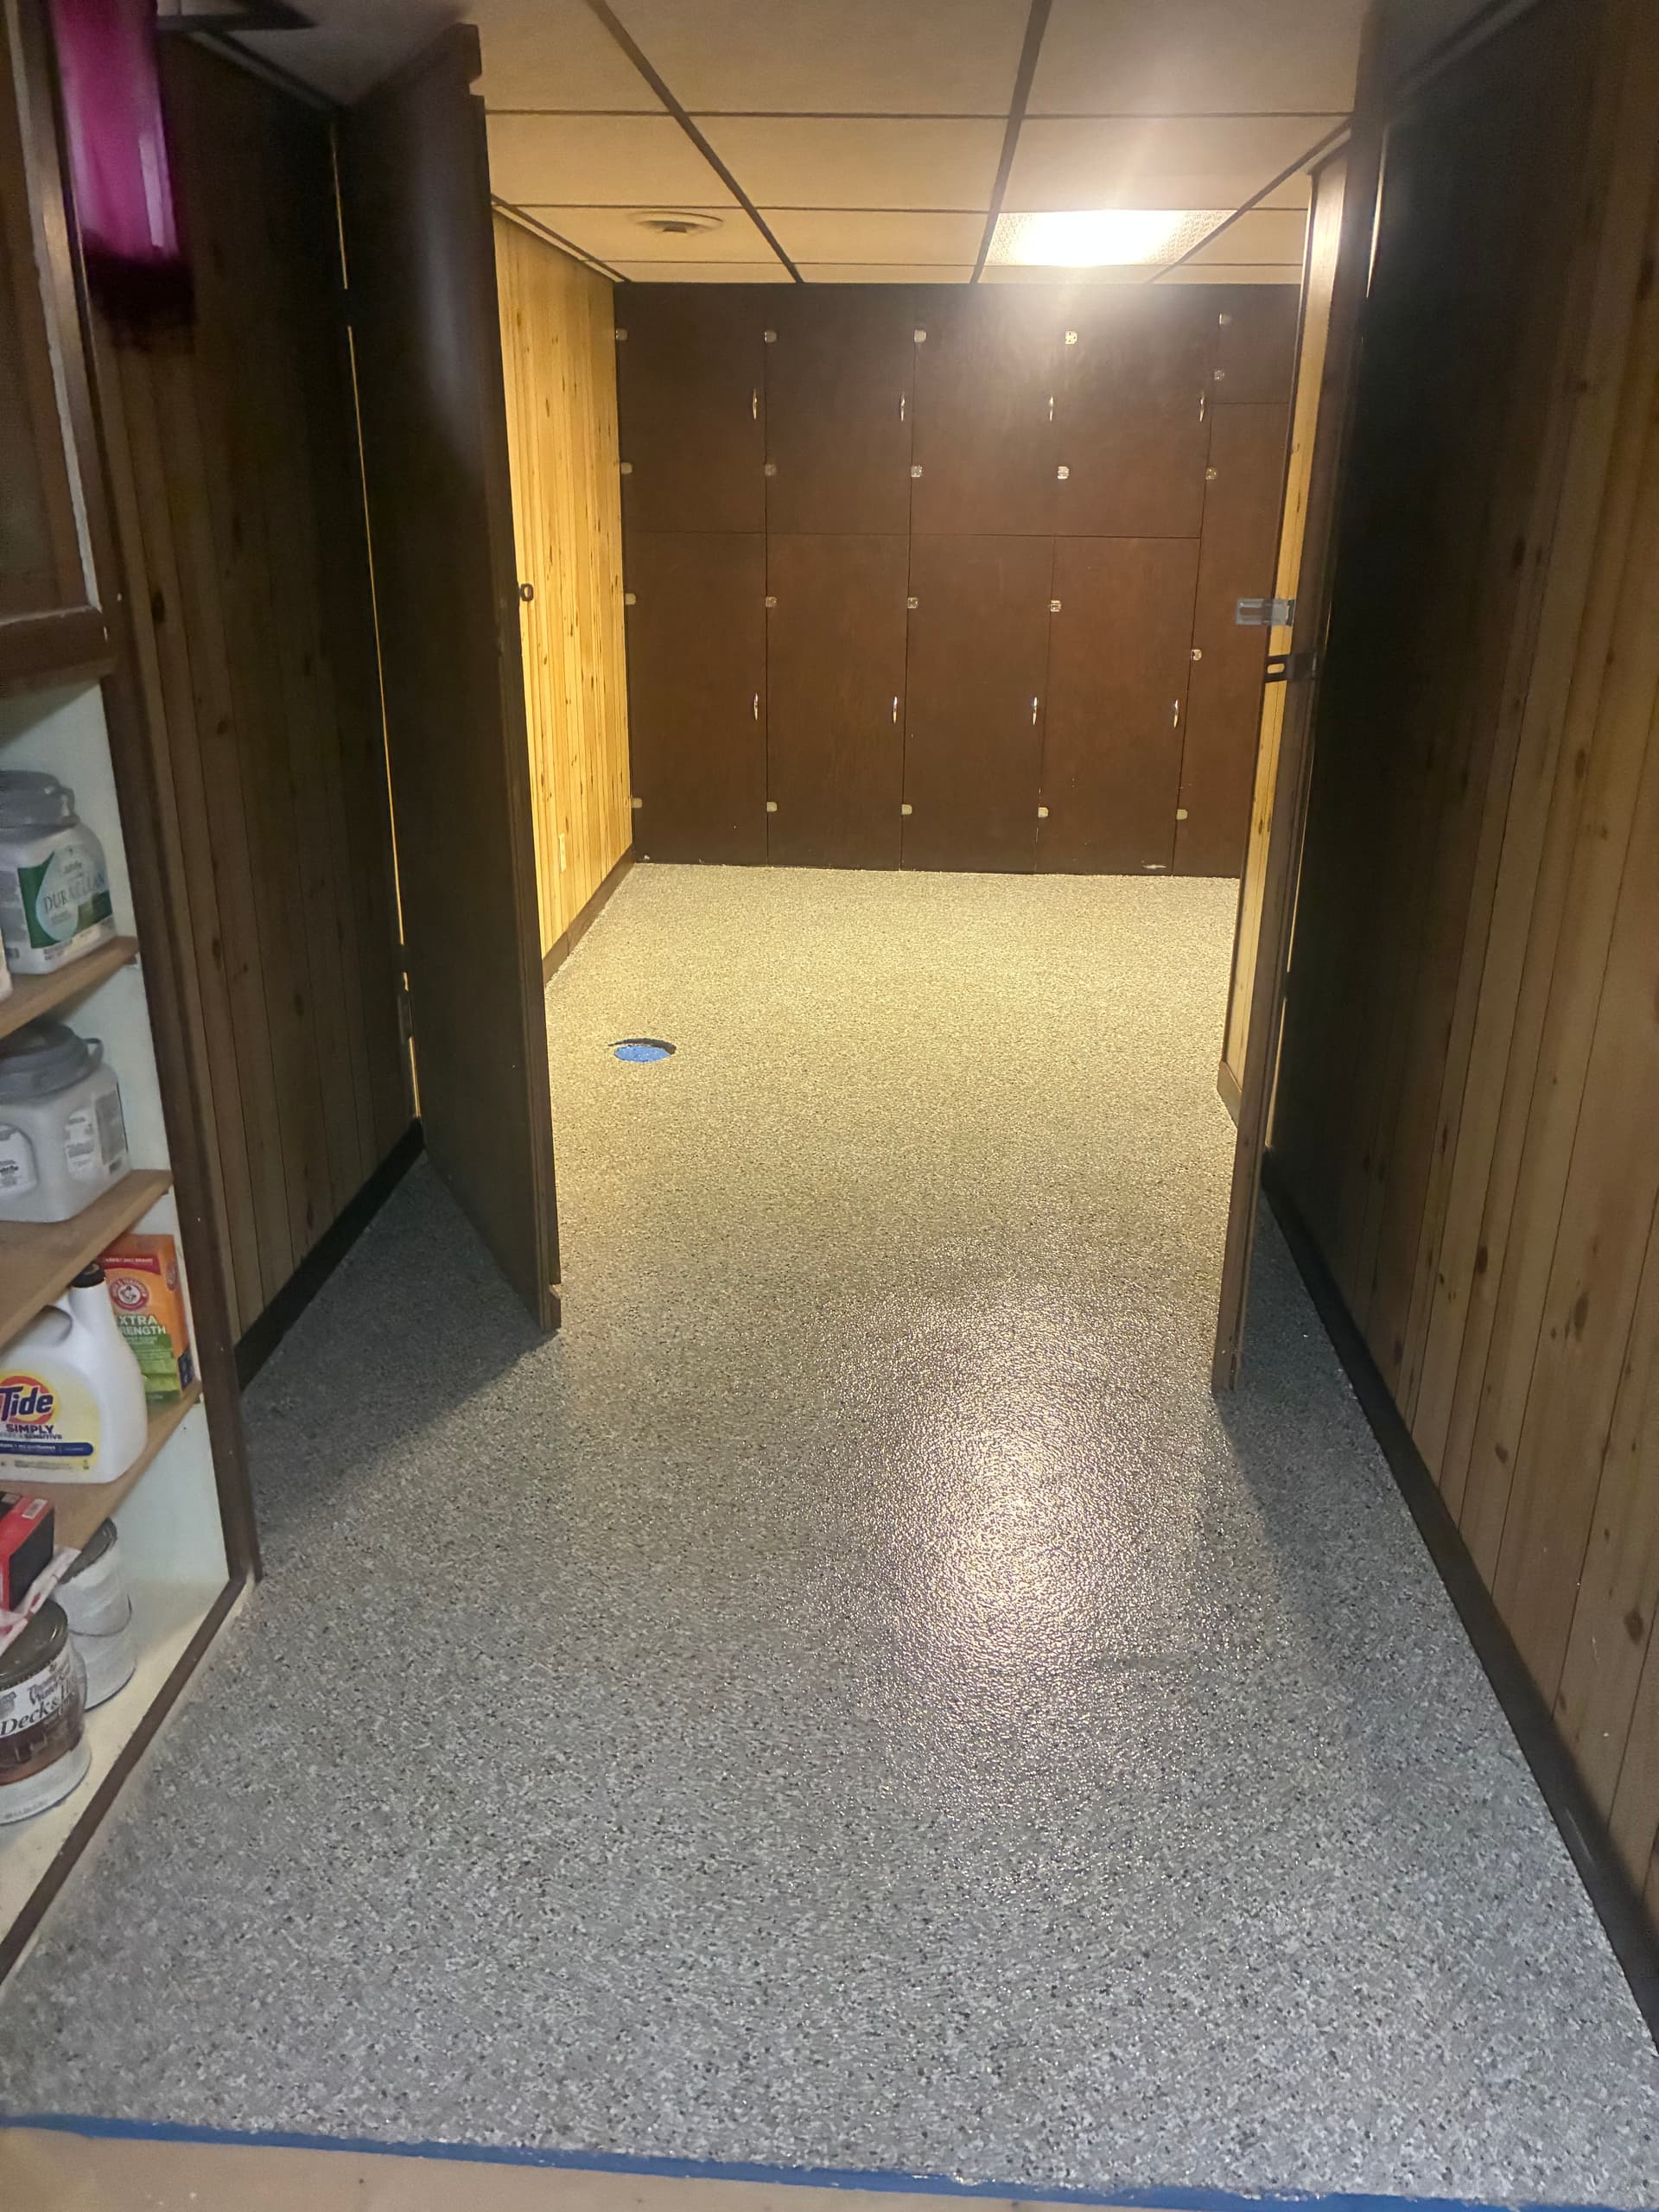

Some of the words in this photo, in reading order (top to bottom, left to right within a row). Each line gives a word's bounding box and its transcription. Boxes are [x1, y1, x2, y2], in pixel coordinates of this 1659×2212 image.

[119, 1315, 157, 1325] XTRA
[0, 1386, 54, 1421] Tide
[6, 1424, 54, 1433] SIMPLY
